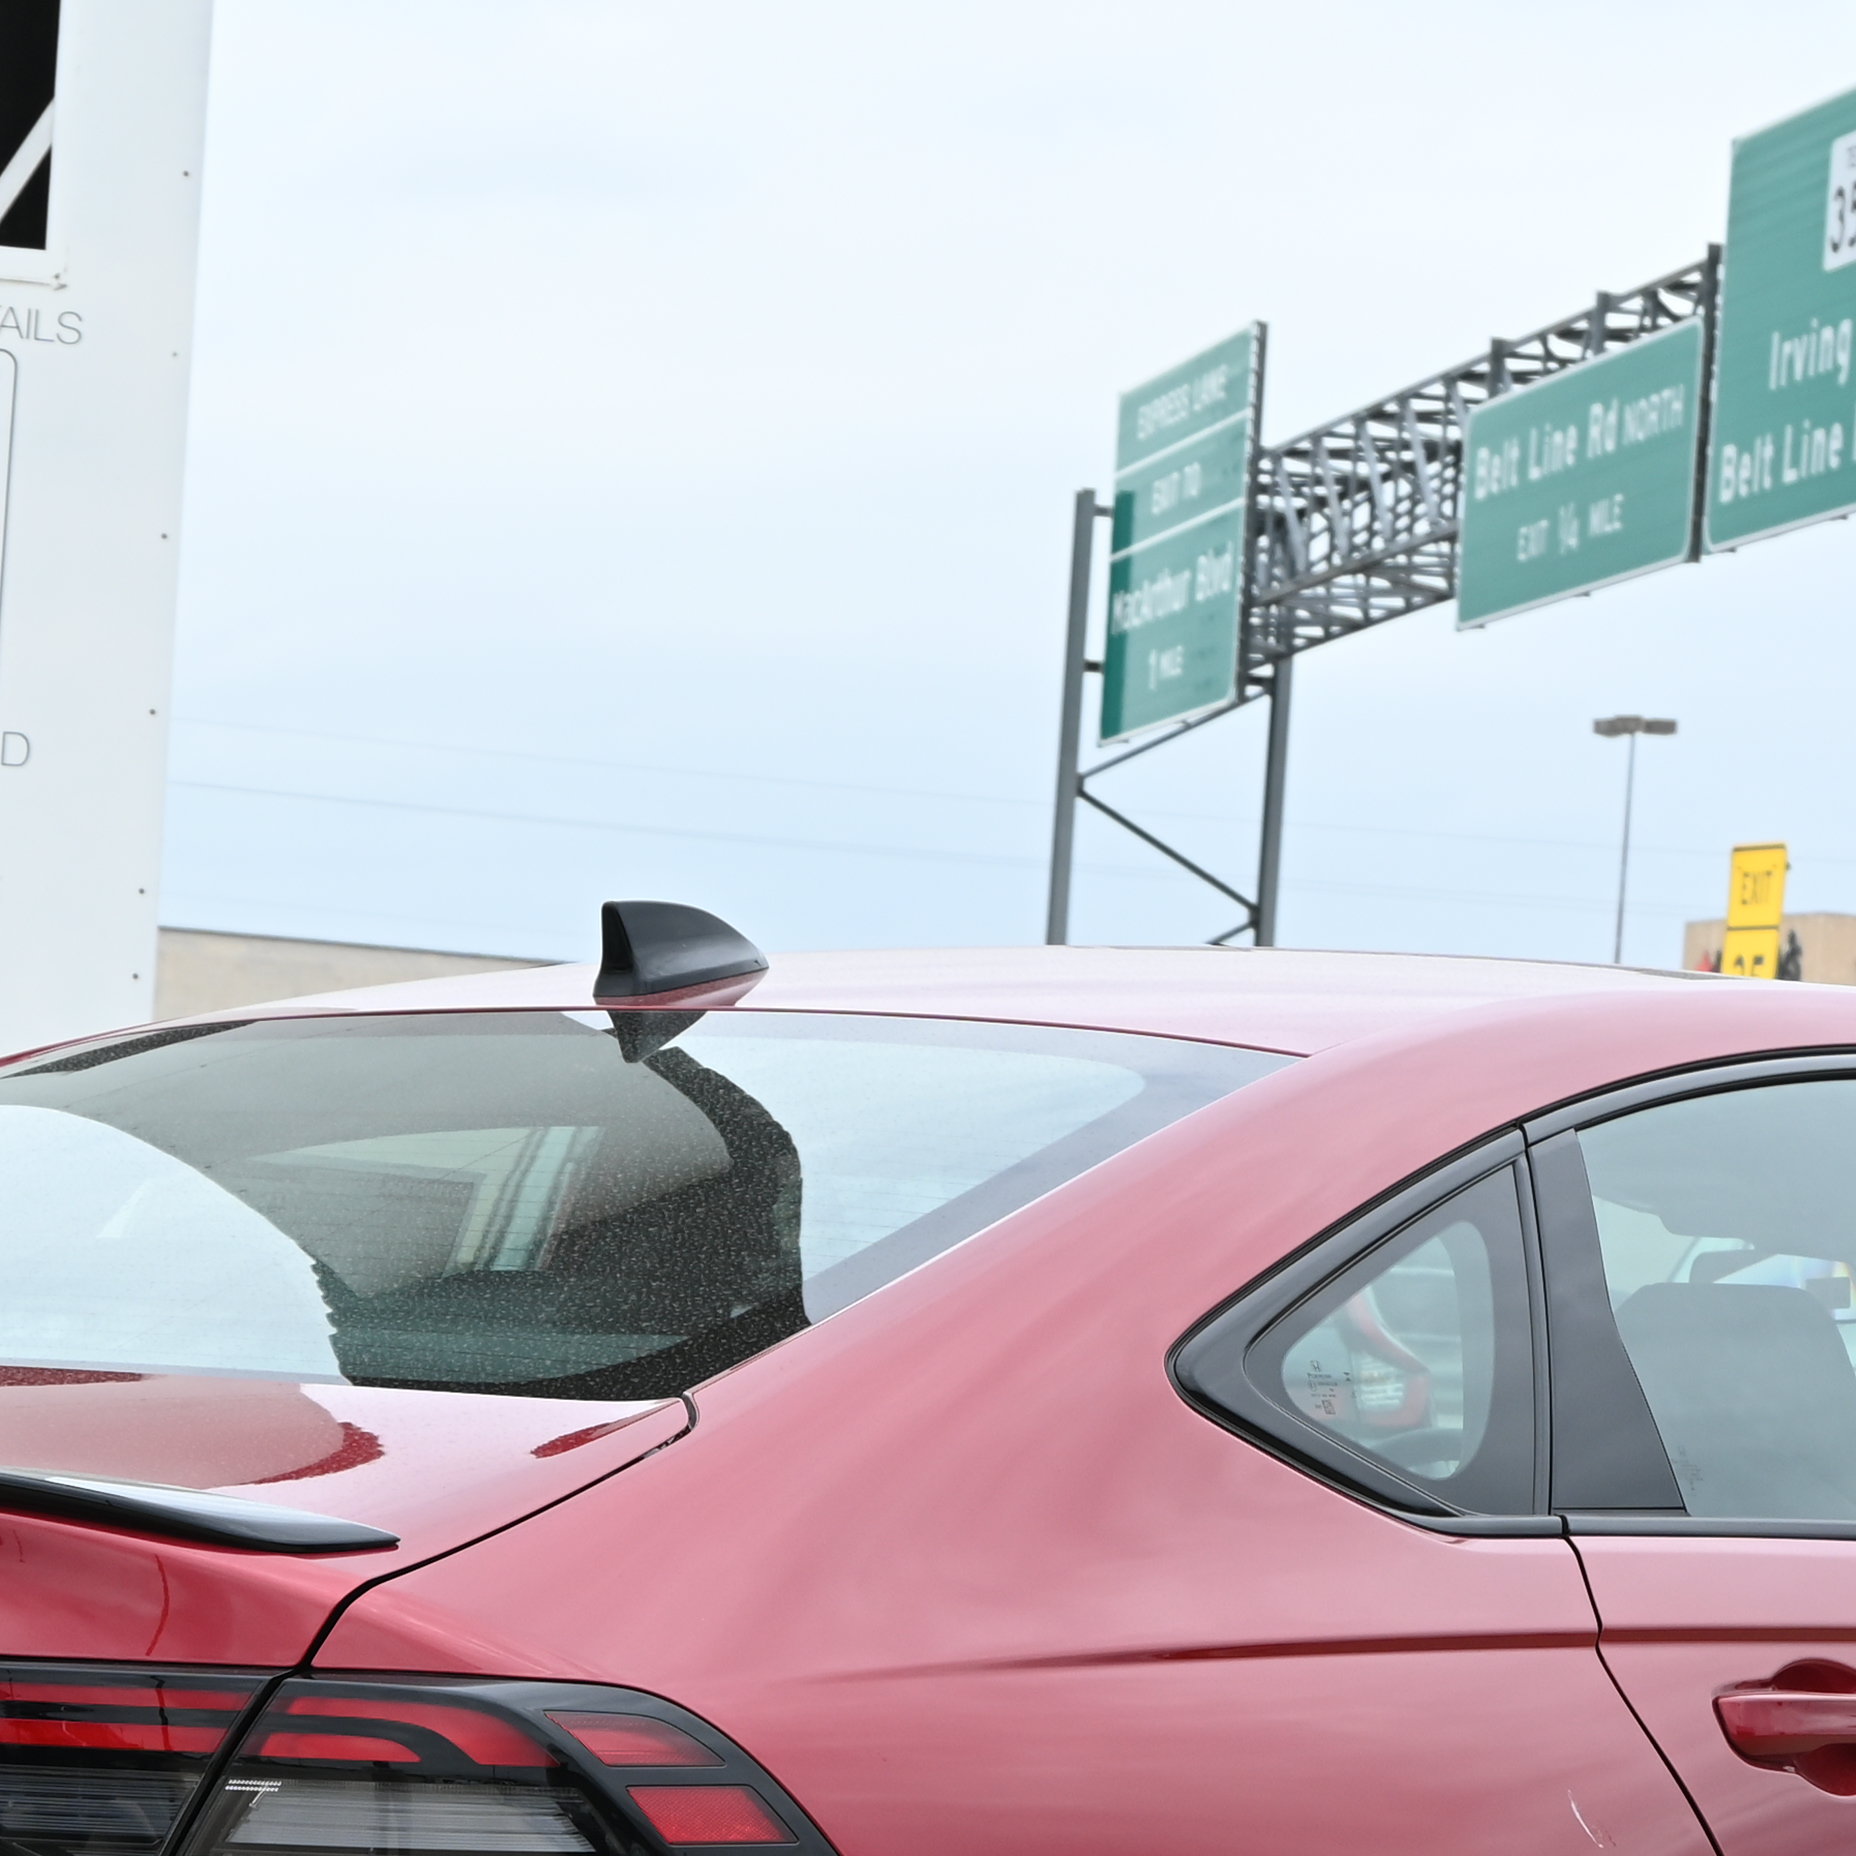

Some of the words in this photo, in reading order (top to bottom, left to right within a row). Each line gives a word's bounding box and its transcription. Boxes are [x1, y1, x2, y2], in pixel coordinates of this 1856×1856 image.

[1768, 314, 1851, 391] Irving
[1474, 437, 1520, 501] Belt
[1528, 413, 1578, 481] Line
[1587, 396, 1619, 460] Rd
[1621, 384, 1684, 448] NORTH
[1717, 442, 1773, 503] Belt
[1782, 416, 1843, 486] Line
[1517, 516, 1549, 562] EXIT
[1588, 493, 1624, 536] MILE
[1196, 541, 1233, 602] Blvd
[1741, 869, 1773, 906] EXIT
